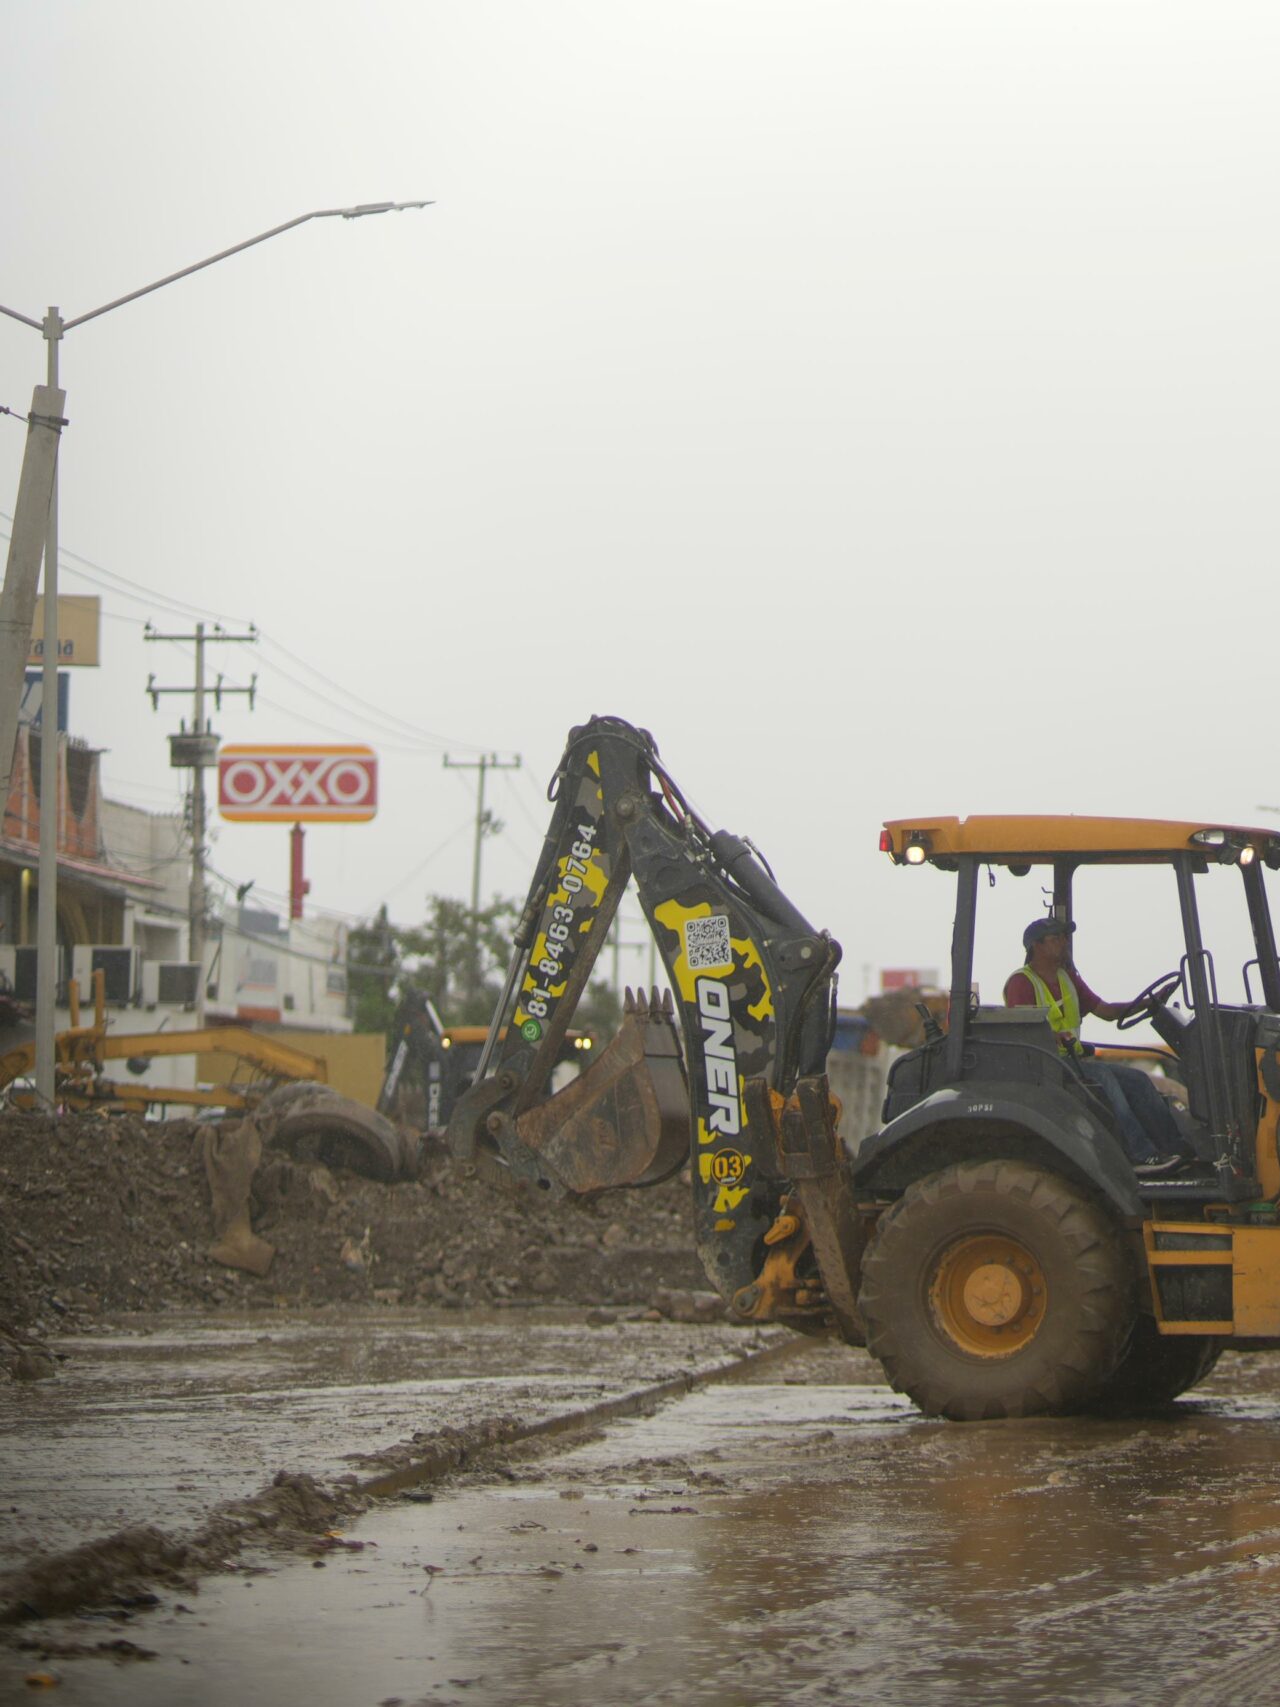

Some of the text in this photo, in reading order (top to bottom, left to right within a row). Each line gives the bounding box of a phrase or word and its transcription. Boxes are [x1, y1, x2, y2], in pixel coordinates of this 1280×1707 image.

[223, 760, 370, 806] OXXO
[527, 824, 598, 1018] 81-8463-0764
[697, 977, 740, 1135] ONER
[714, 1155, 742, 1178] 03
